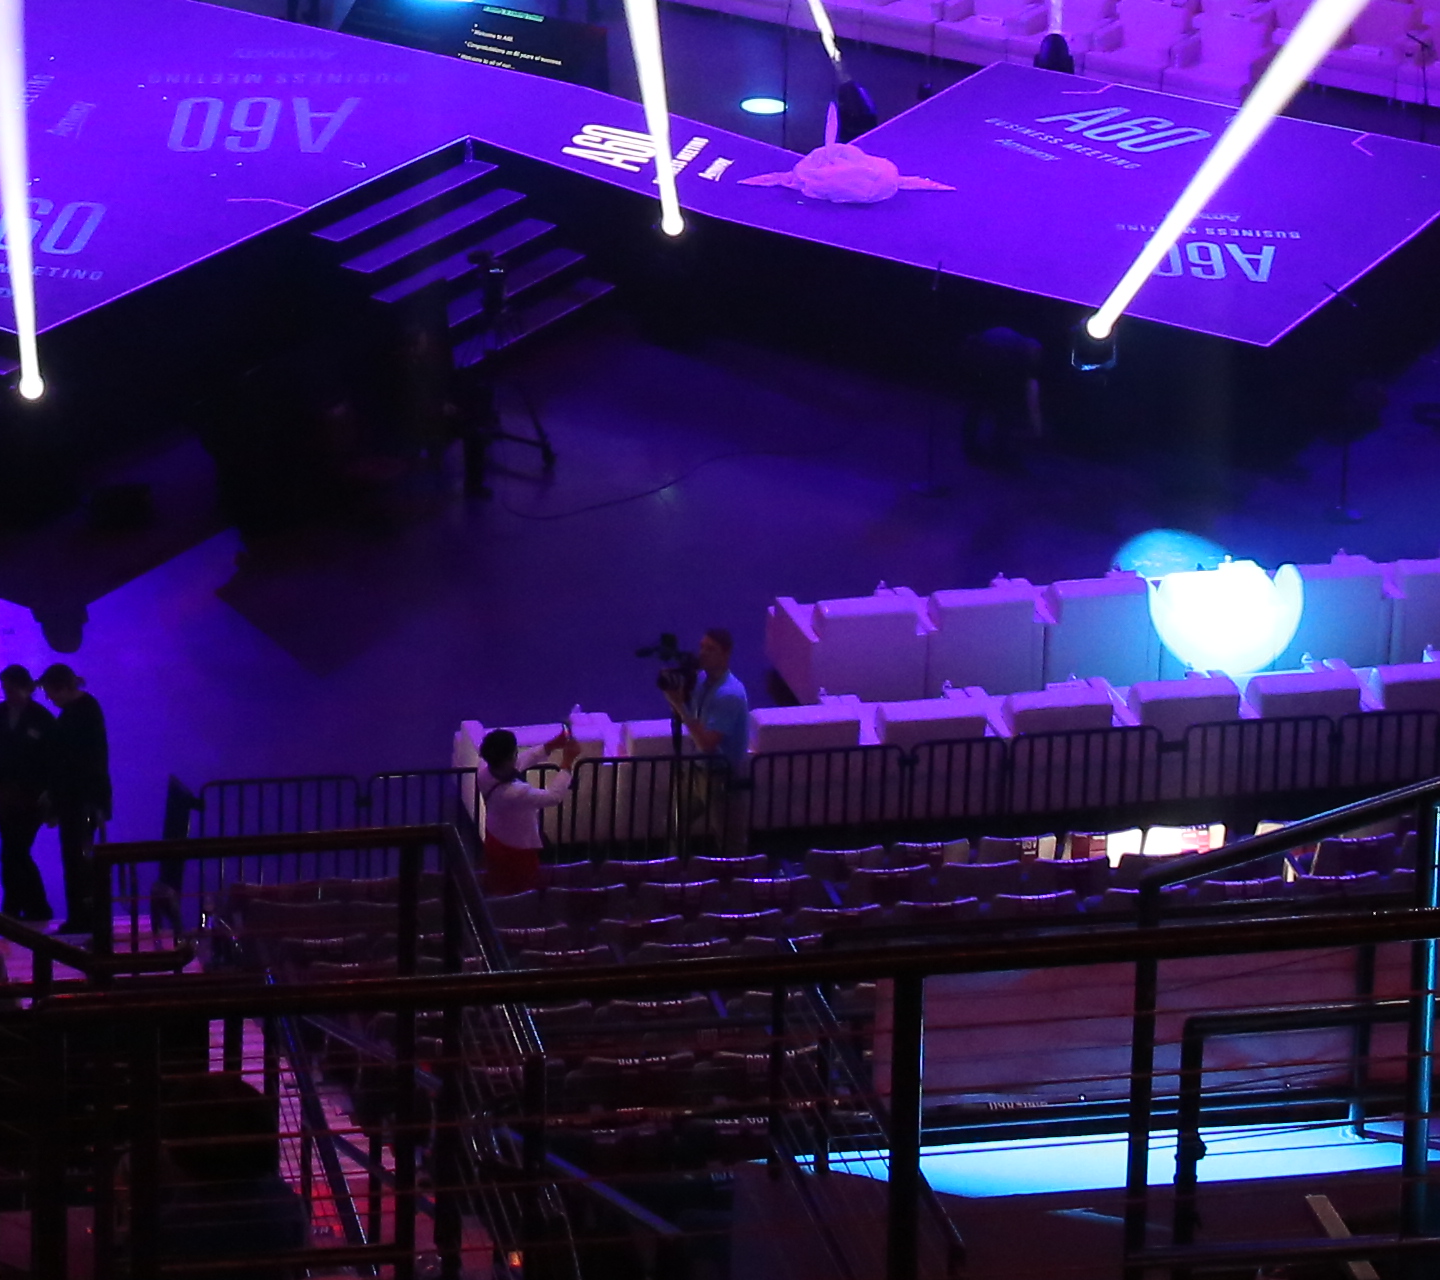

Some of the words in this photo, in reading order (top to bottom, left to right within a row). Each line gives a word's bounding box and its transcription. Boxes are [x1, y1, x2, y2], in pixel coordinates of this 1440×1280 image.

[167, 96, 362, 154] A60
[1035, 106, 1212, 153] A60
[1063, 142, 1141, 170] MEETING
[1205, 226, 1301, 240] BUSINESS
